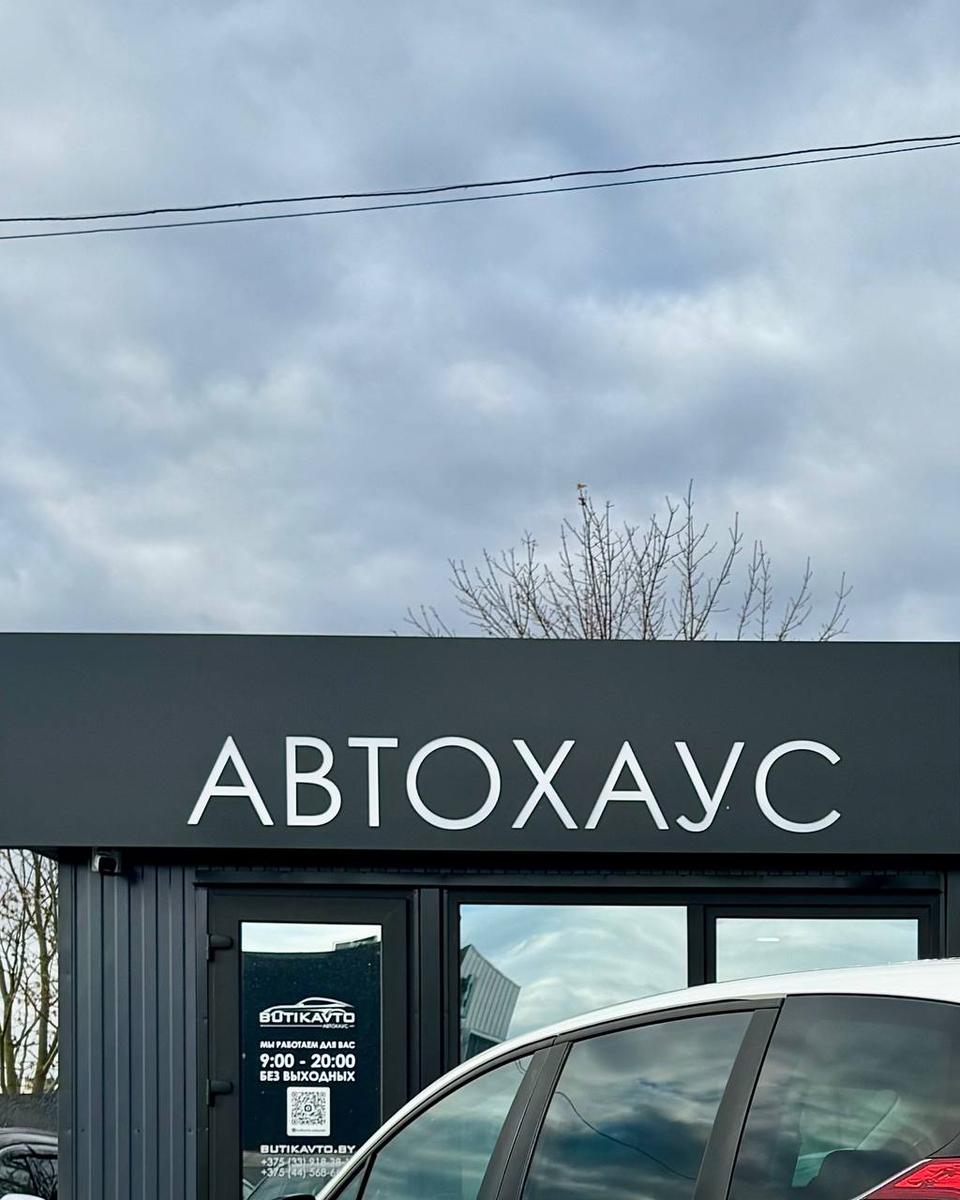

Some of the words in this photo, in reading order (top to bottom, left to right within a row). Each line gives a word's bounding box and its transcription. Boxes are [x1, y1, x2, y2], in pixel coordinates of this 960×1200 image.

[187, 735, 842, 834] АВТОХАУС
[259, 1011, 356, 1023] BUTIKAVTO
[319, 1041, 337, 1049] ДЛЯ
[260, 1053, 295, 1068] 9:00
[310, 1053, 356, 1068] 20:00
[260, 1071, 280, 1081] БЕЗ
[283, 1071, 356, 1082] ВЫХОДНЫХ
[260, 1145, 356, 1154] BUTIKAVTO.BY
[261, 1157, 285, 1167] +375
[288, 1157, 306, 1169] (33)
[261, 1168, 285, 1177] +375
[288, 1167, 306, 1179] (44)
